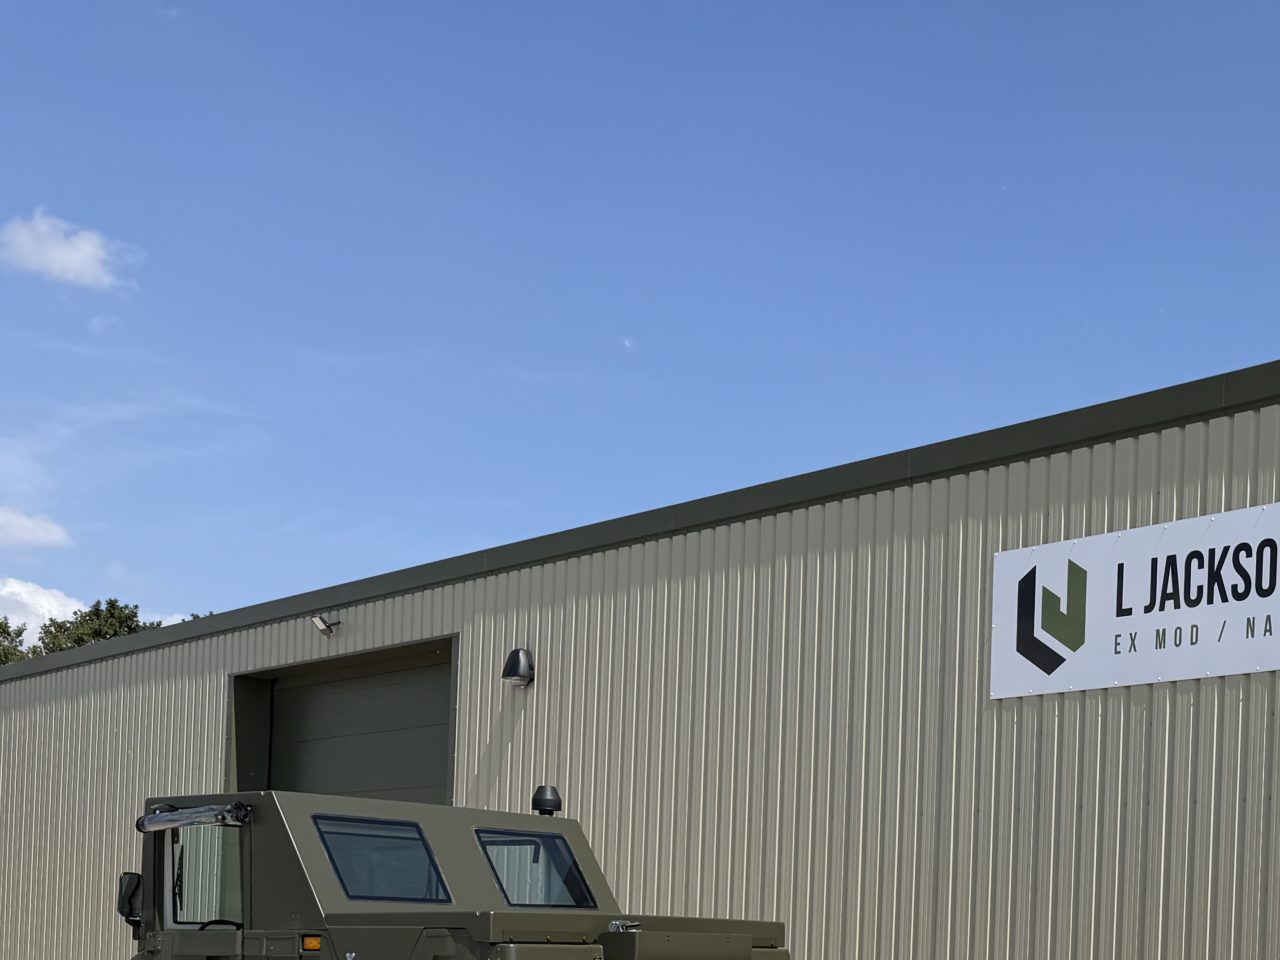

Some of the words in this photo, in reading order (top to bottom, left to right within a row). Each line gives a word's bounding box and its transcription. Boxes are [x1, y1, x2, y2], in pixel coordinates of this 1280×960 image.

[1115, 562, 1134, 618] L
[1113, 631, 1138, 655] EX
[1154, 624, 1200, 651] MOD
[1217, 619, 1228, 643] /
